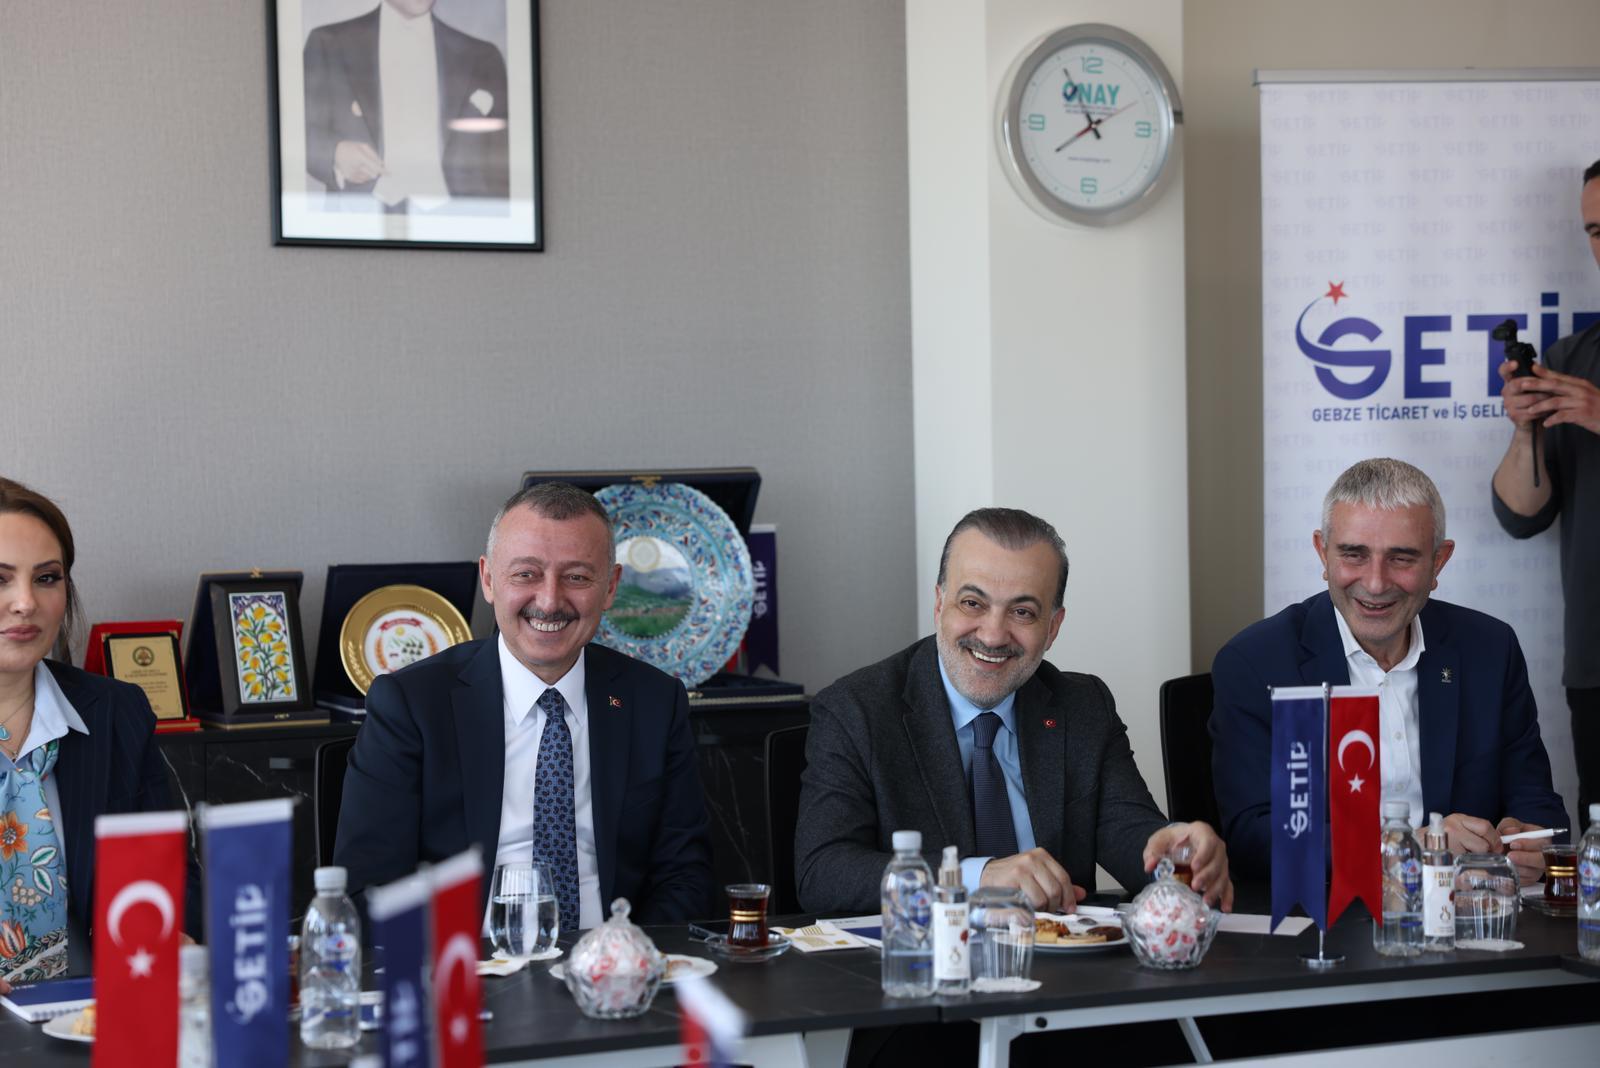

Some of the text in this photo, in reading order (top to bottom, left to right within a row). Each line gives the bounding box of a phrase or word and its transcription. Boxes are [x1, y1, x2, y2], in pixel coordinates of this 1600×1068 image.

[1081, 56, 1103, 74] 12
[1028, 113, 1045, 131] 9
[1135, 120, 1152, 138] 3
[1081, 177, 1098, 195] 6
[1296, 292, 1600, 400] GETİ
[1312, 400, 1505, 422] GEBZE TİCARET ve İŞ GELİ
[1283, 741, 1309, 839] GETİP
[224, 884, 268, 1026] GETİP
